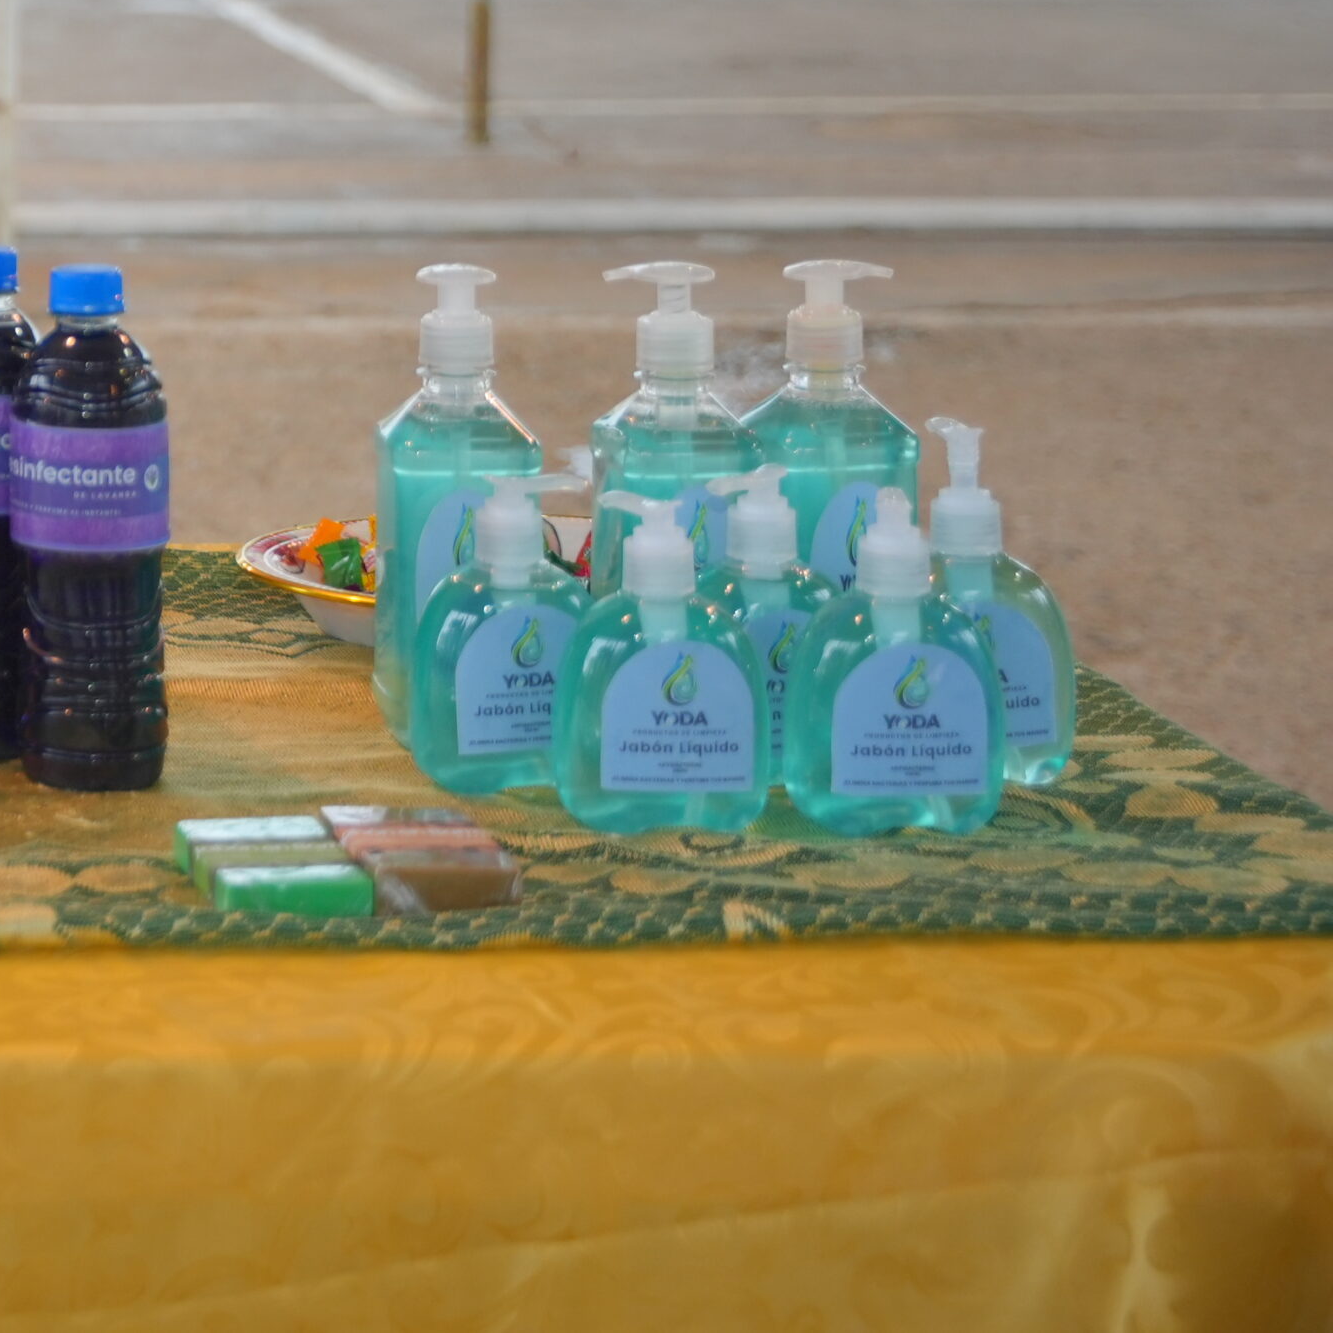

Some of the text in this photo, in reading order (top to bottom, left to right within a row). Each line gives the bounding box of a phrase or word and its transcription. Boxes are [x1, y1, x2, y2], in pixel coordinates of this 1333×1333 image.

[503, 671, 555, 689] YODA
[474, 702, 524, 716] Jabón
[1006, 696, 1041, 709] uido
[651, 710, 708, 726] YODA
[883, 713, 941, 729] YODA
[619, 739, 673, 753] Jabón
[850, 743, 905, 757] Jabón
